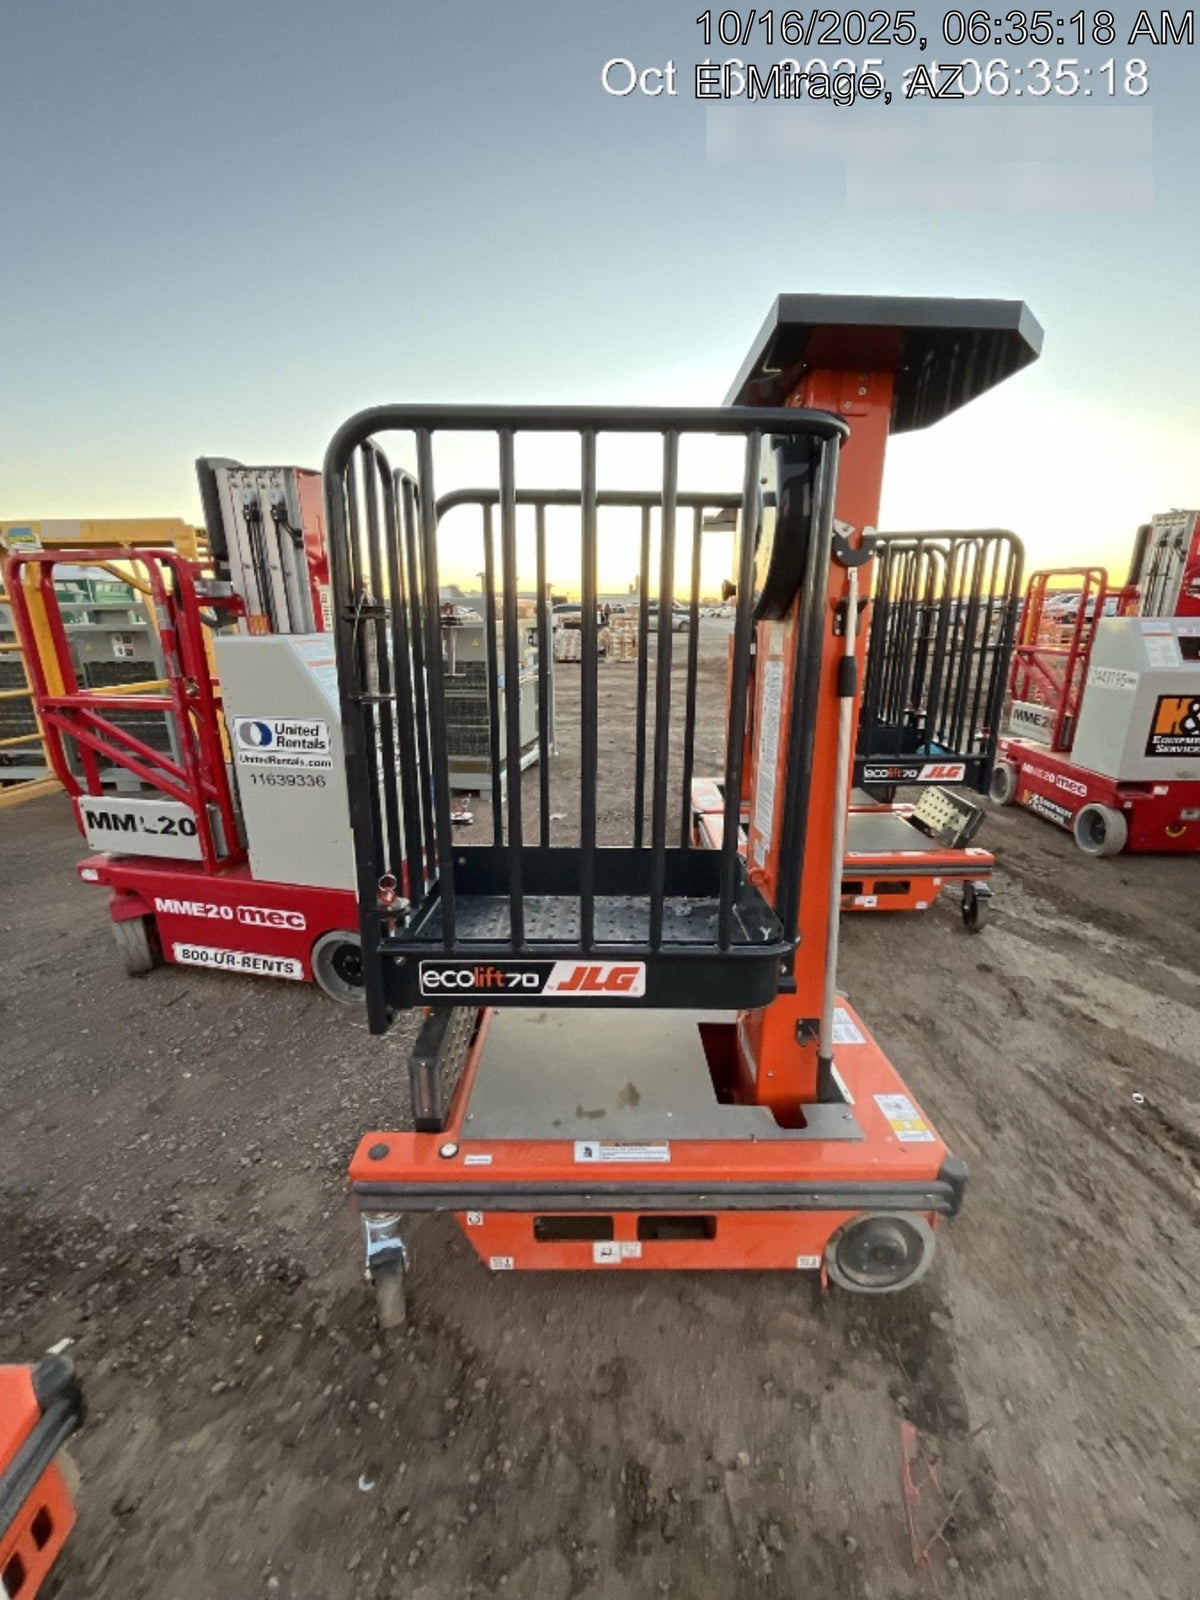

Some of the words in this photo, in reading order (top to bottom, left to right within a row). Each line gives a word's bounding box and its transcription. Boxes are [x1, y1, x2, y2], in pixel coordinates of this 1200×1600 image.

[274, 723, 319, 737] United
[276, 736, 326, 749] Rentals
[240, 755, 331, 768] UnitedRentals.com
[924, 766, 962, 779] JLG
[250, 773, 326, 788] 11639336
[1056, 775, 1087, 797] mec
[154, 897, 233, 920] MME20
[238, 906, 306, 929] mec
[182, 948, 295, 975] 800-UR-RENTS
[422, 966, 540, 988] ecolift70
[556, 966, 641, 991] JLG
